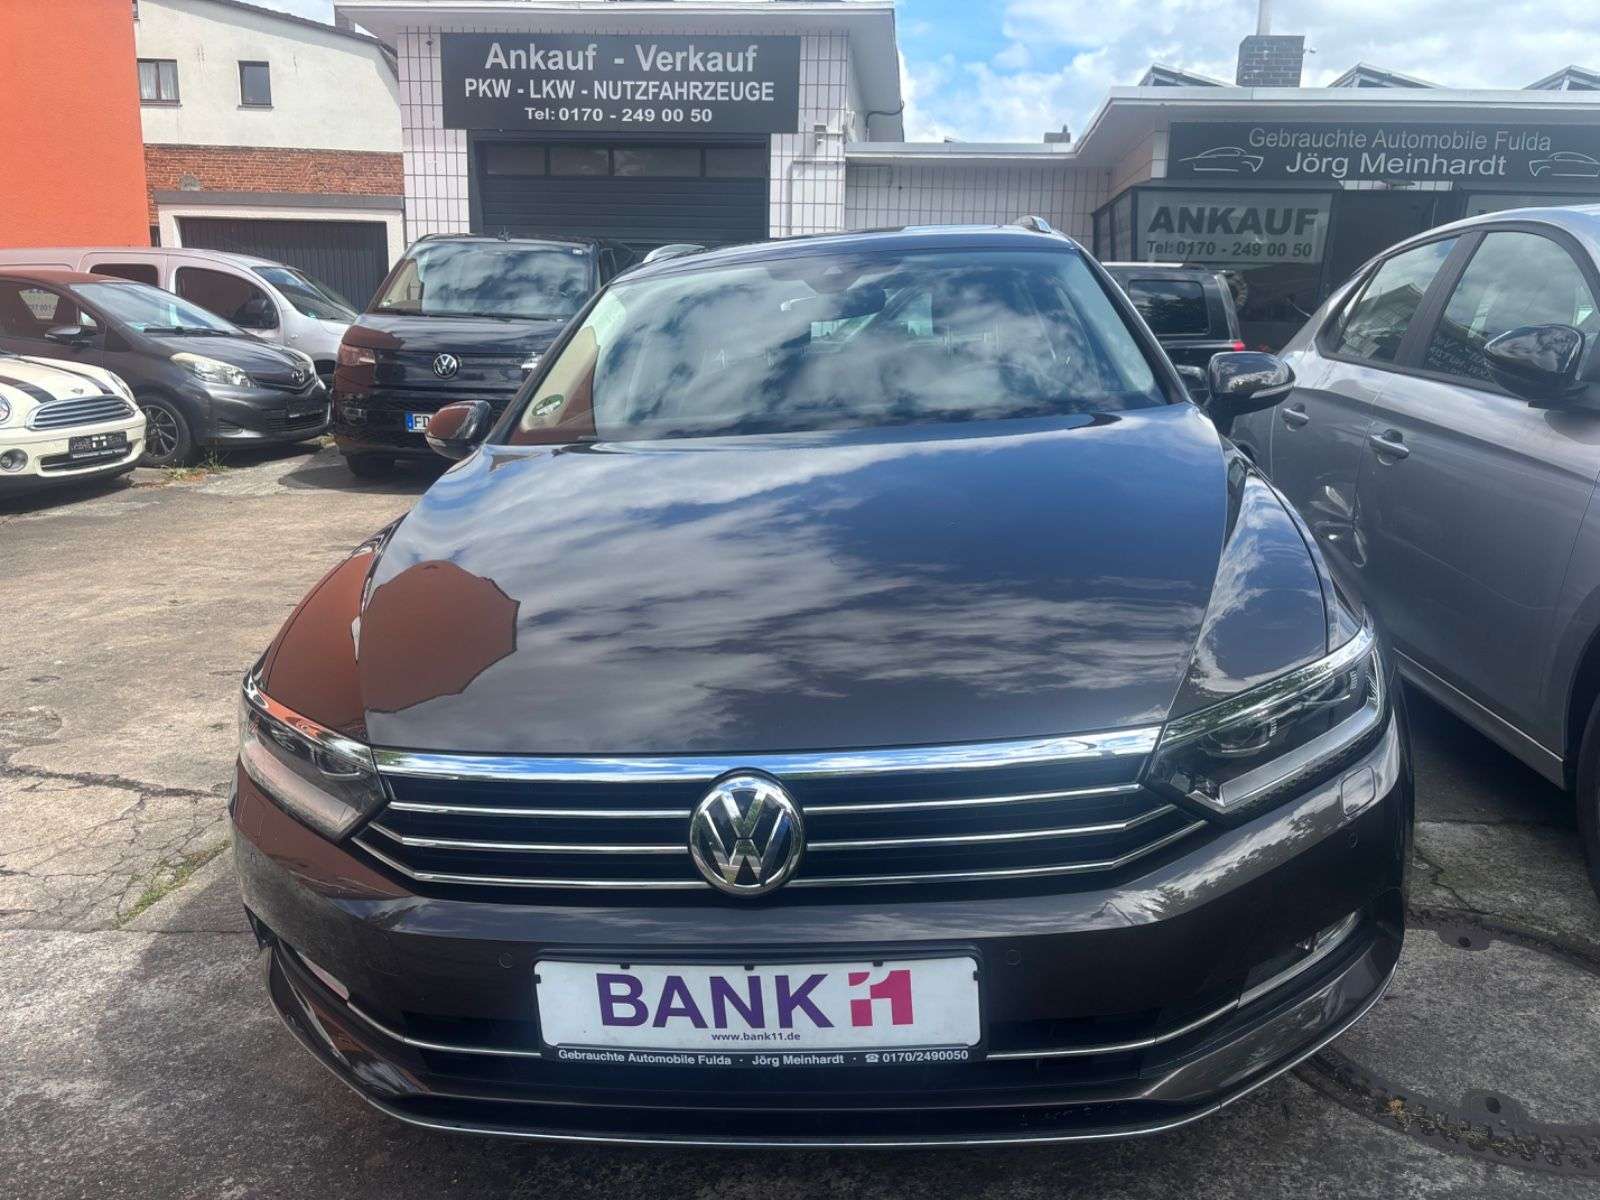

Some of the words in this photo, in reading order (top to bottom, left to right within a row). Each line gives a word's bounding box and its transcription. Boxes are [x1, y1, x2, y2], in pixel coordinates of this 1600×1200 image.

[484, 42, 598, 71] Ankauf
[634, 44, 758, 73] Verkauf
[464, 78, 512, 98] PKW
[529, 79, 576, 99] LKW
[593, 80, 775, 102] NUTZFAHRZEUGE
[621, 108, 656, 122] 249
[661, 108, 684, 122] 00
[690, 108, 713, 123] 50
[1248, 128, 1367, 149] Gebrauchte
[1372, 129, 1488, 150] Automobile
[1495, 131, 1552, 152] Fulda
[1285, 152, 1349, 179] Jörg
[1359, 152, 1507, 176] Meinhardt
[1147, 206, 1319, 236] ANKAUF
[1231, 242, 1263, 257] 249
[1267, 242, 1288, 258] 00
[1291, 242, 1313, 258] 50
[595, 973, 835, 1030] BANK
[711, 1031, 802, 1042] www.bank11.de
[557, 1049, 626, 1062] Gebrauchte
[628, 1052, 696, 1065] Automobile
[697, 1054, 732, 1066] Fulda
[751, 1054, 780, 1068] Jörg
[782, 1054, 845, 1066] Meinhardt
[882, 1050, 969, 1063] 0170/2490050
